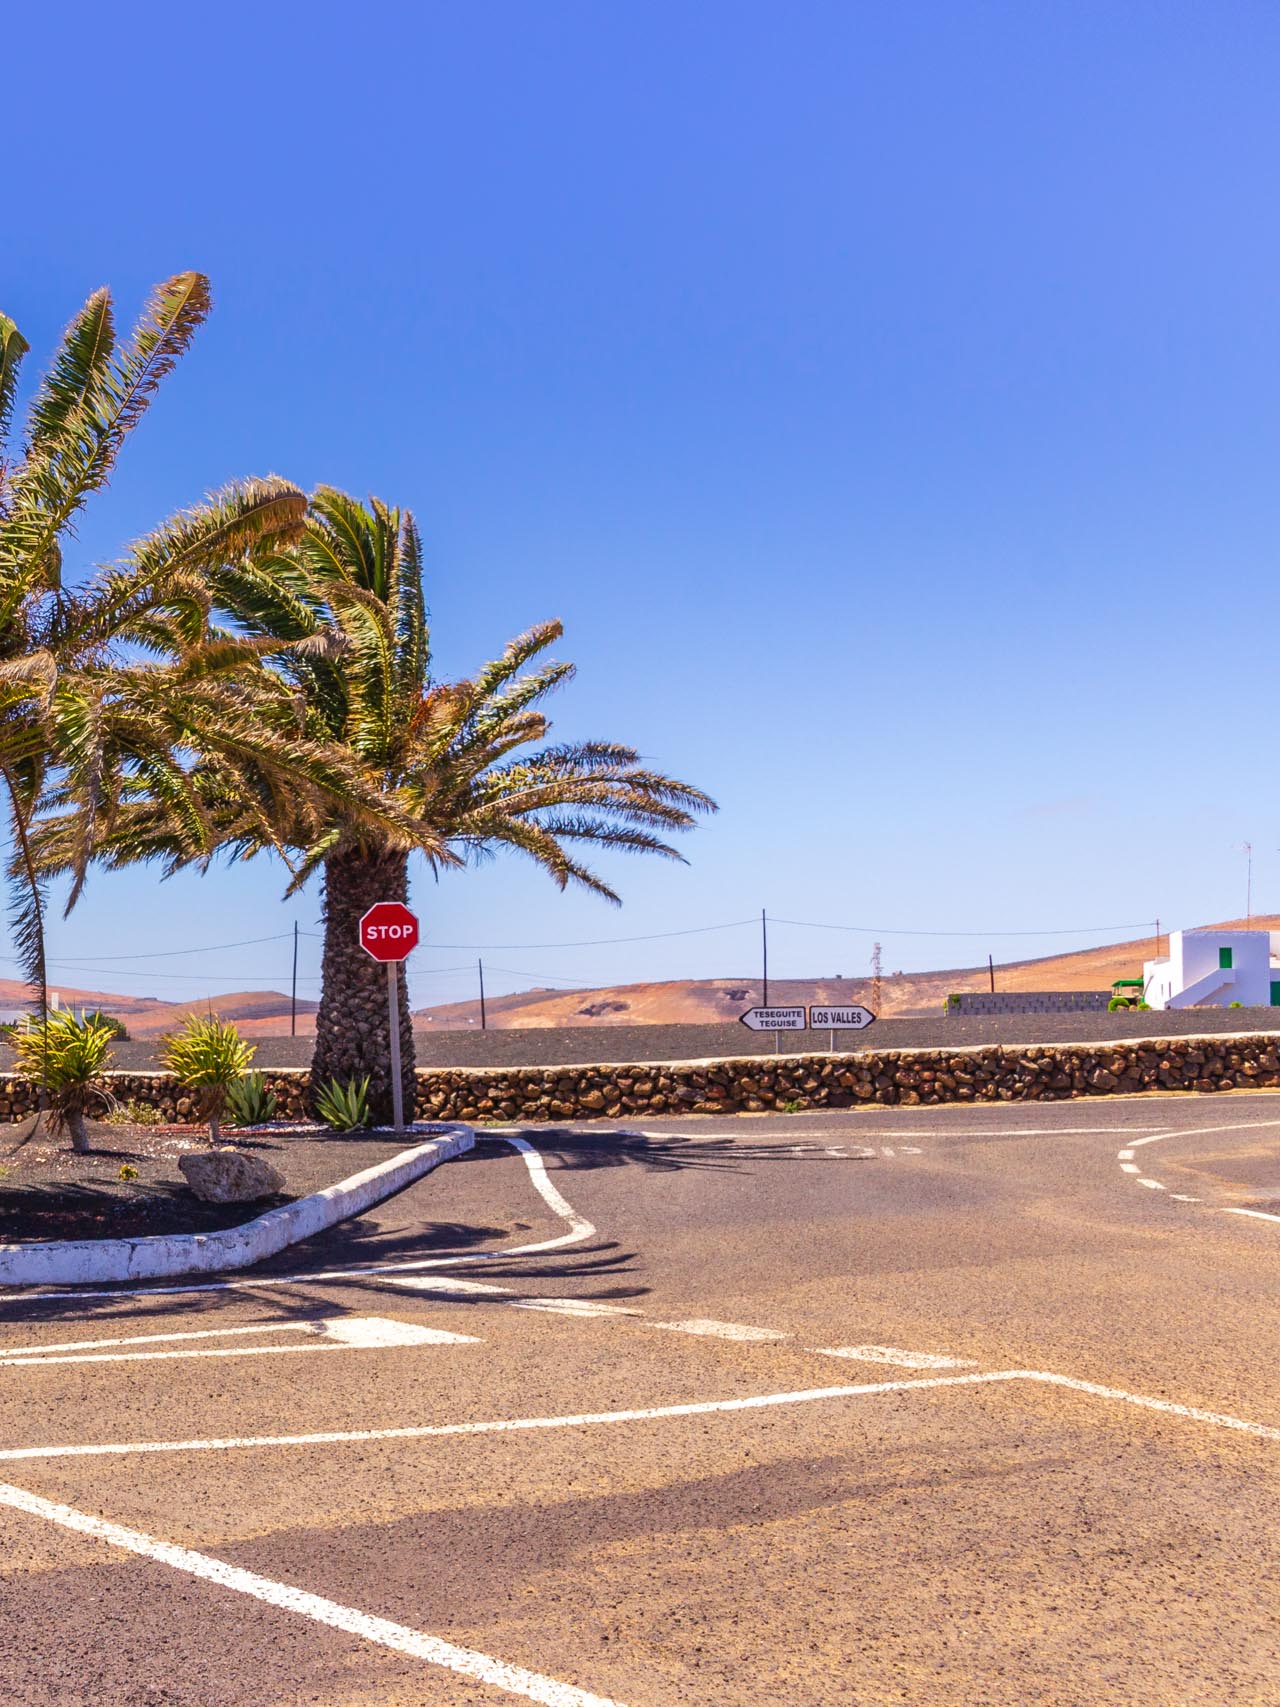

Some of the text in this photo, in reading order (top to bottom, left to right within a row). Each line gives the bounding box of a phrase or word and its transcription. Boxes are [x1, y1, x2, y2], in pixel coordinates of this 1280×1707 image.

[366, 925, 413, 939] STOP
[812, 1012, 862, 1024] LOS VALLES
